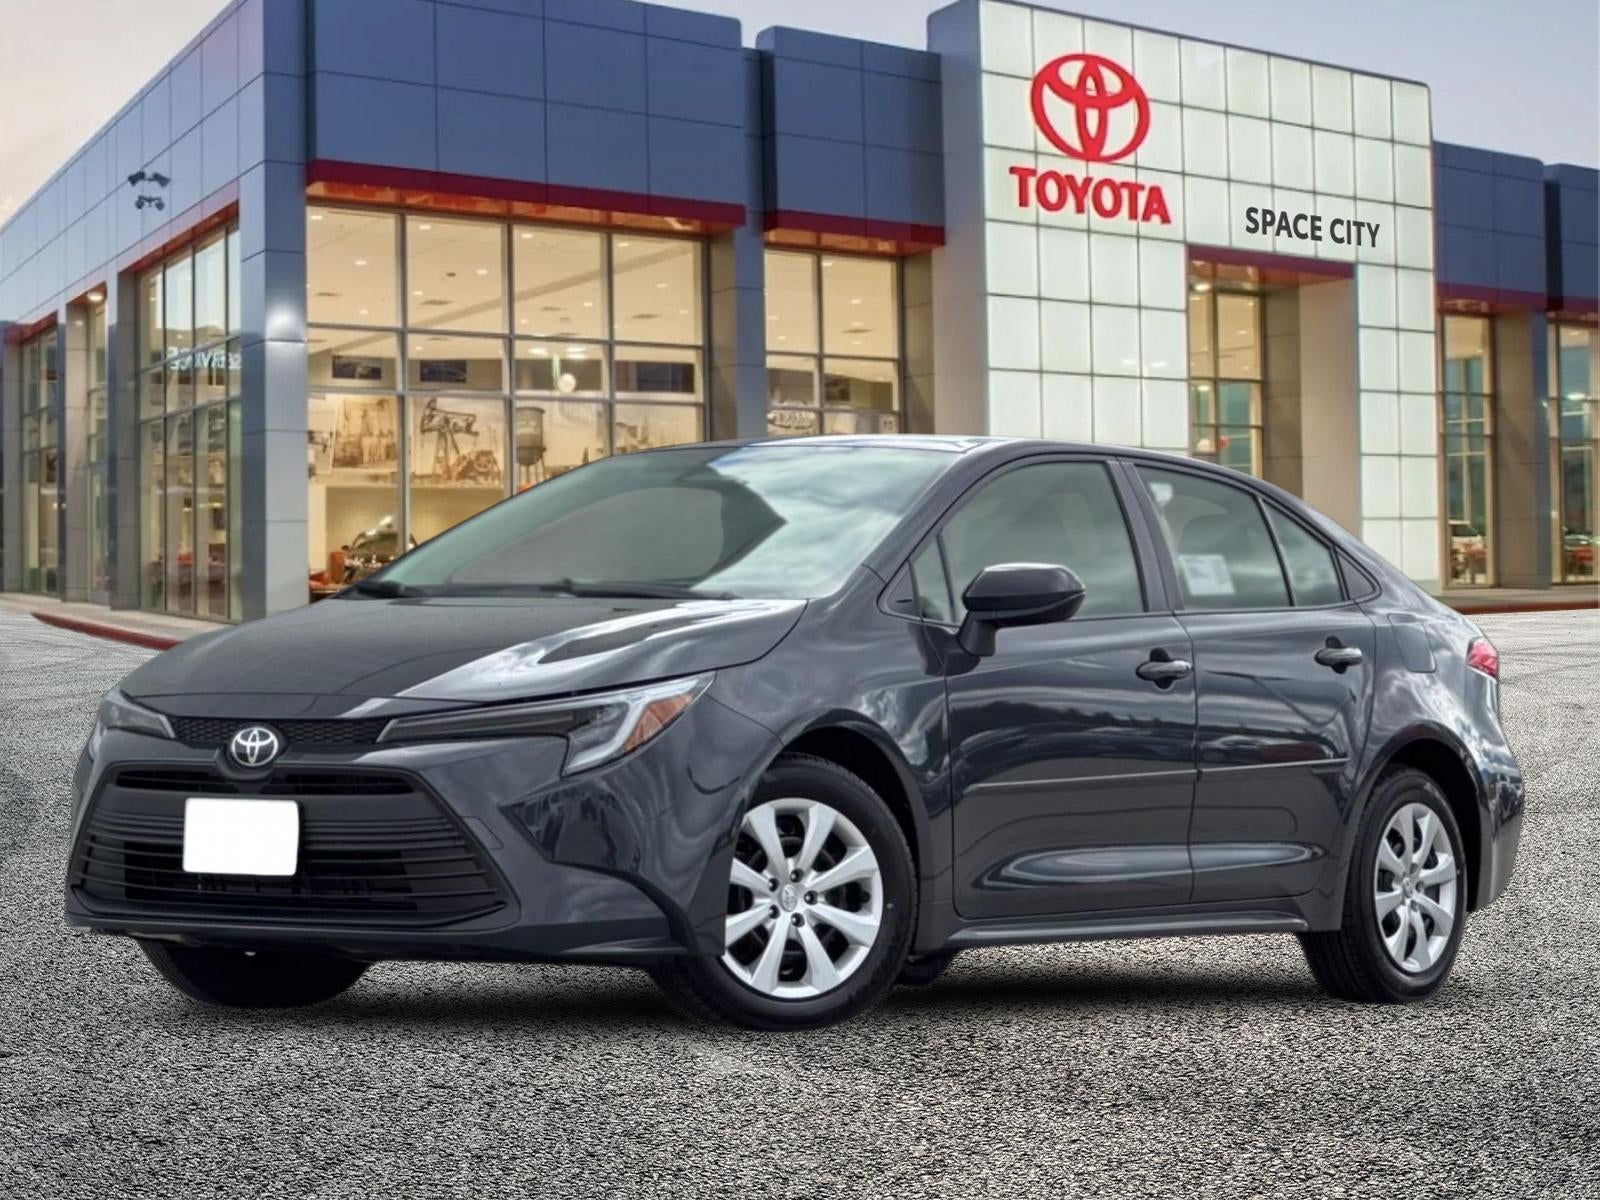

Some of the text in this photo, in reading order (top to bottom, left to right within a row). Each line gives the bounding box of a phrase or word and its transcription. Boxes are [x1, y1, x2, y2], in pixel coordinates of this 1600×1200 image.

[1009, 166, 1171, 224] TOYOTA
[1245, 206, 1380, 248] SPACE CITY
